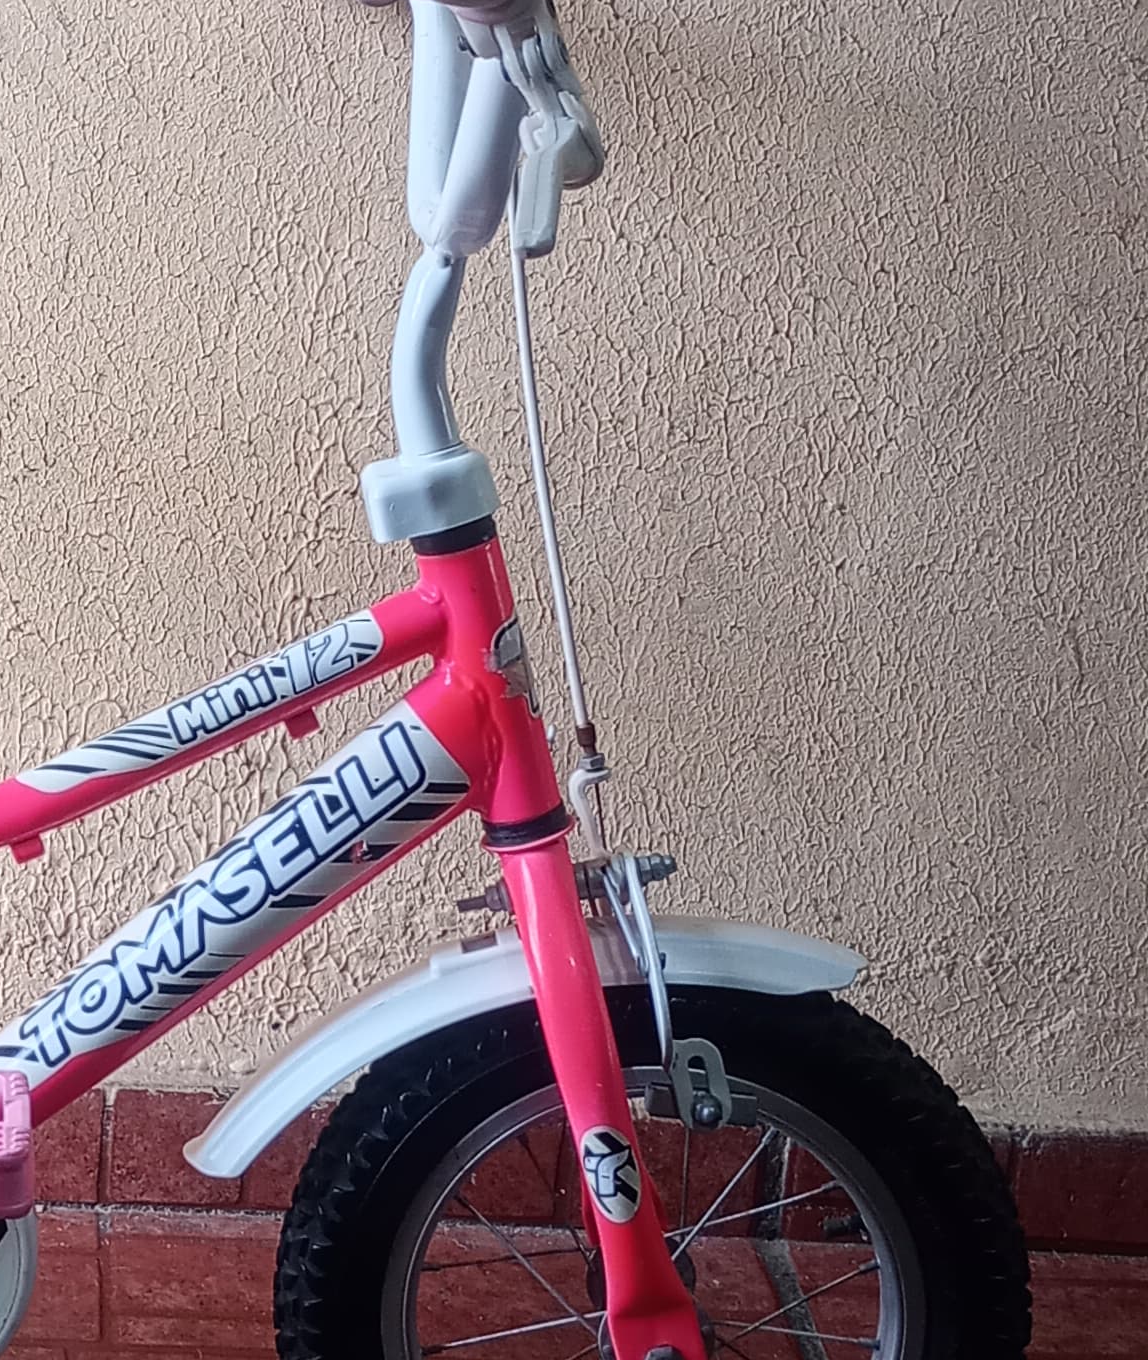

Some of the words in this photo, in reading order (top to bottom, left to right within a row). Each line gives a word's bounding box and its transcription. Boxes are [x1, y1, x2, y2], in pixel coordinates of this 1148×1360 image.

[167, 664, 278, 745] Mini
[280, 622, 354, 696] 12
[20, 721, 427, 1067] TOMASELLI
